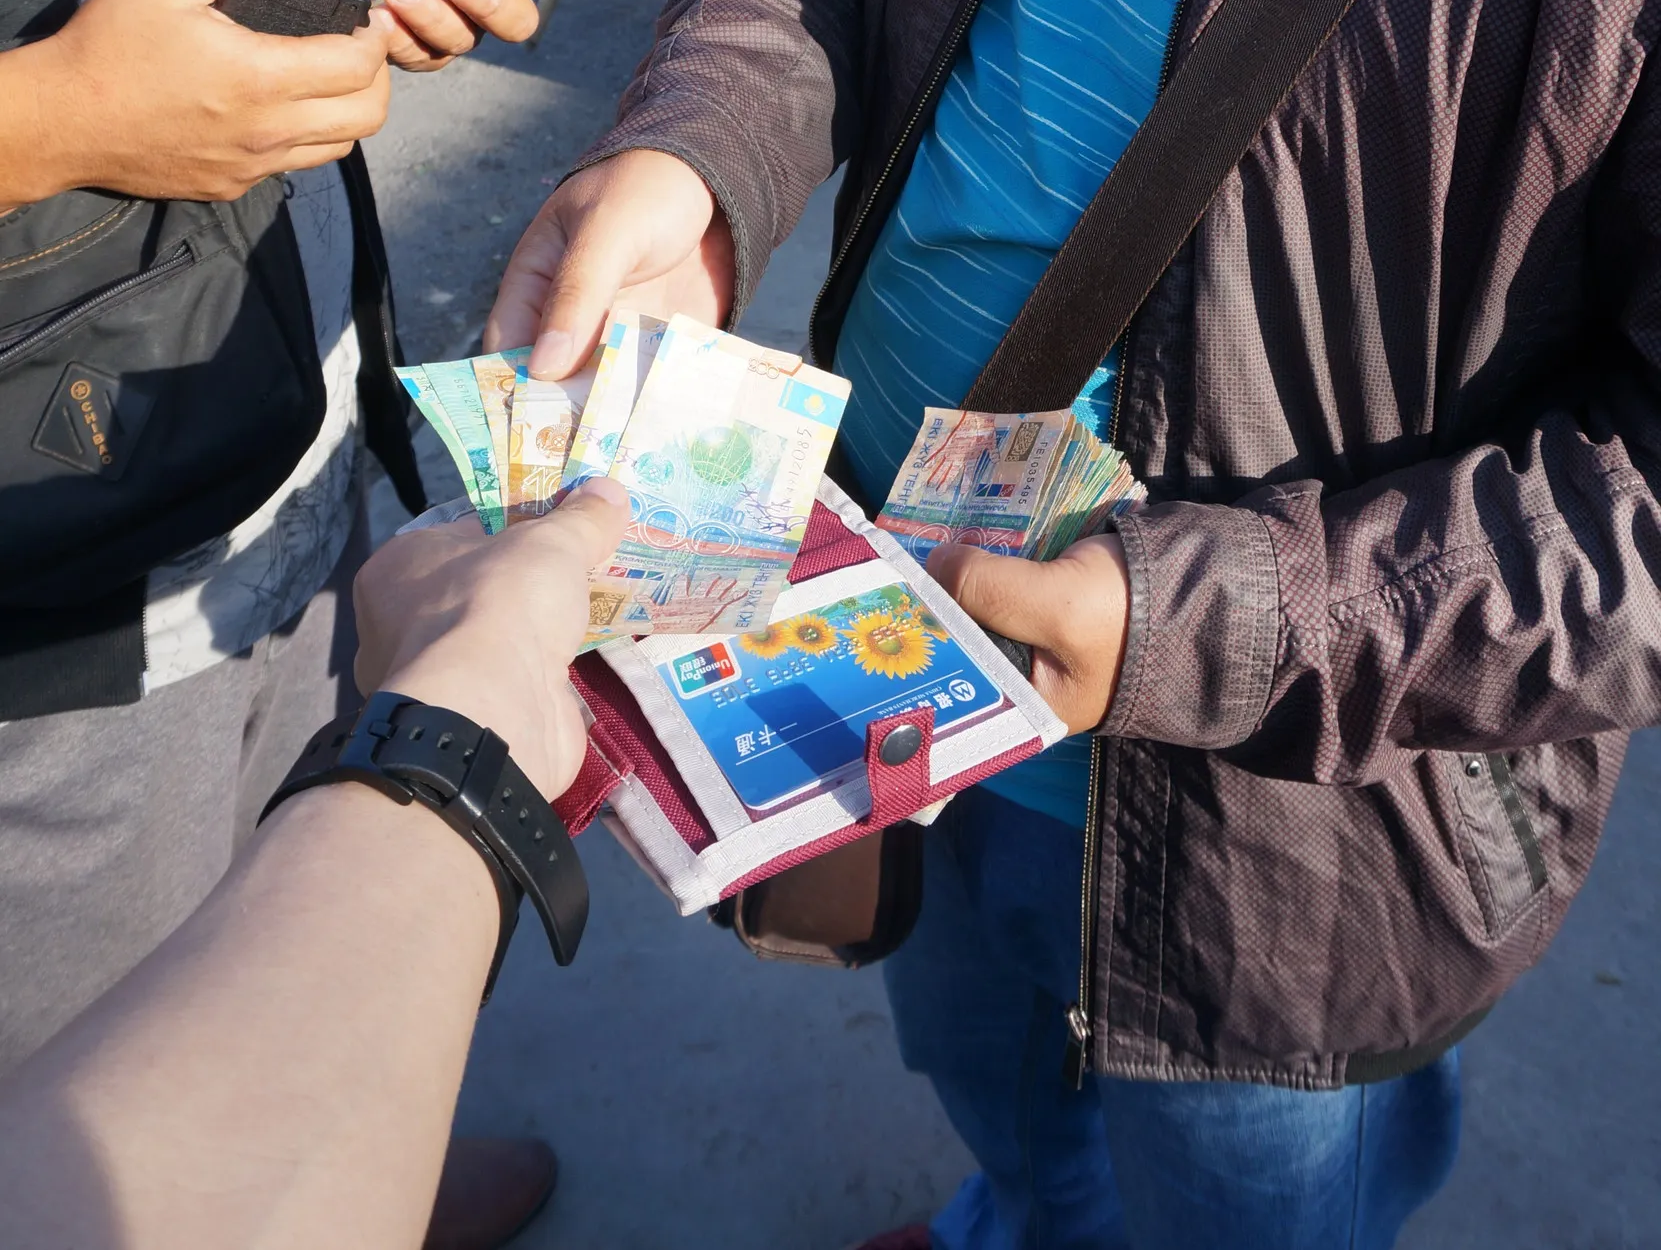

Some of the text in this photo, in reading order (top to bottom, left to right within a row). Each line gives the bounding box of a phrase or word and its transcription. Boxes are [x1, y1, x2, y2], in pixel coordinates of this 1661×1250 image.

[747, 358, 780, 380] 200
[680, 659, 731, 682] UnionPay
[735, 722, 798, 757] 一卡通
